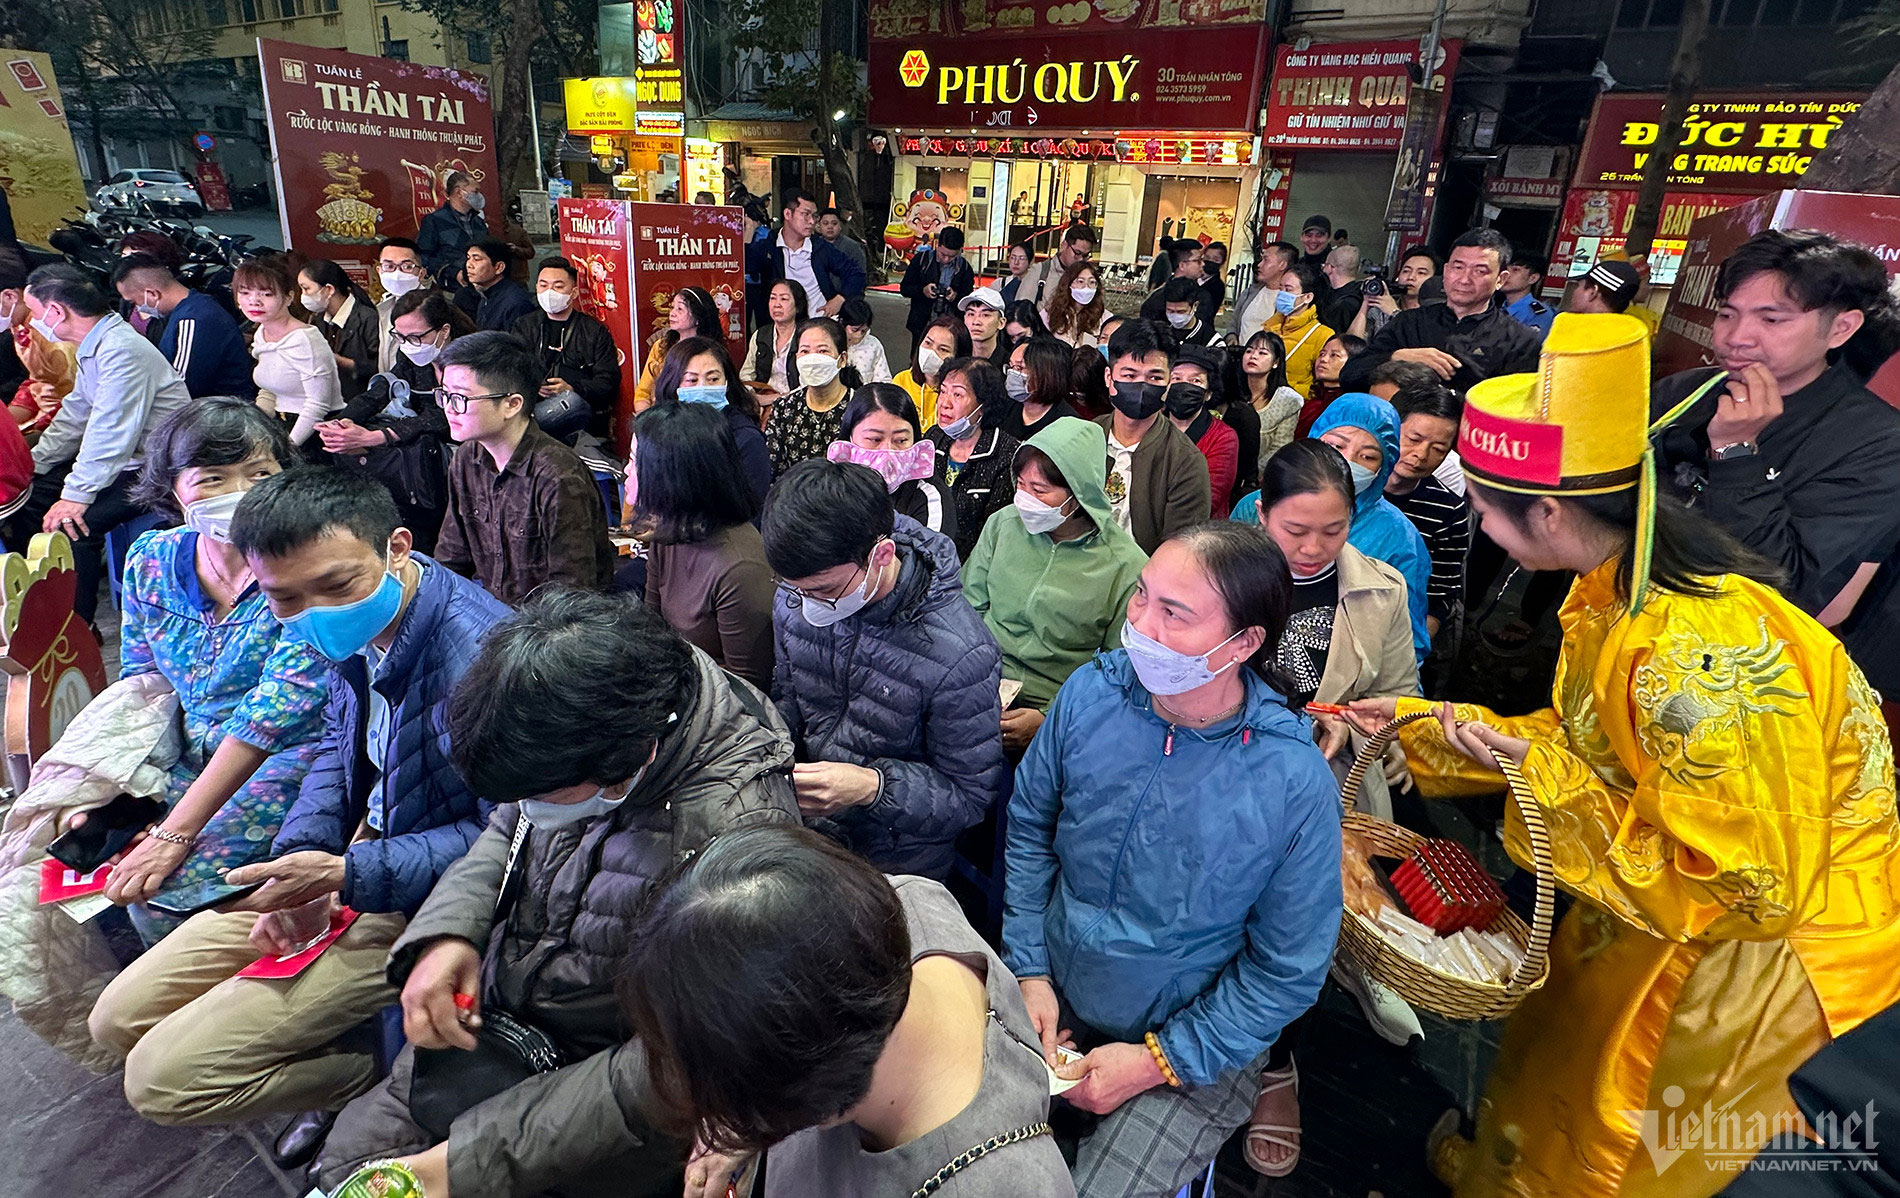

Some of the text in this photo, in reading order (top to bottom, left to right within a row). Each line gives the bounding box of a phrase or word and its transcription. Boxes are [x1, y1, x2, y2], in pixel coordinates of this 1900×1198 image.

[1286, 53, 1307, 67] CÔNG
[1309, 55, 1319, 66] TY
[1320, 52, 1342, 66] VÀNG
[1342, 54, 1360, 68] BẠC
[314, 63, 347, 77] TUẦN
[349, 66, 363, 80] LỄ
[937, 54, 1140, 104] PHÚ QUÝ
[1157, 67, 1175, 83] 30
[1197, 71, 1220, 82] NHÂN
[1221, 71, 1243, 82] TÔNG
[636, 81, 658, 105] NGỌC
[1156, 84, 1207, 94] 024 3573 5959
[1277, 76, 1354, 111] THỊNH
[314, 80, 466, 125] THẦN TÀI
[1155, 94, 1232, 104] www.phuquy.com.vn
[1702, 103, 1720, 113] TY
[1723, 103, 1761, 113] TNHH
[1764, 100, 1797, 113] BẢO
[1799, 100, 1823, 113] TÍN
[290, 114, 483, 146] RƯỚC LỘC VÀNG RỒNG HANH THÔNG THUẬN PHÁT
[1287, 112, 1305, 128] GIỮ
[1305, 113, 1321, 128] TÍN
[1321, 113, 1351, 131] NHIỆM
[1351, 114, 1374, 129] NHƯ
[1373, 112, 1391, 128] GIỮ
[1393, 113, 1406, 128] VÀ
[1619, 113, 1747, 148] ĐỨC
[631, 141, 646, 149] PATE
[1694, 153, 1763, 174] TRANG
[1766, 152, 1813, 175] SÚC
[1511, 180, 1544, 195] BÁNH
[1600, 172, 1617, 181] 26
[1676, 175, 1705, 184] TÔNG
[417, 206, 436, 215] MIN
[1659, 198, 1697, 236] BÁN
[598, 216, 616, 236] TÀI
[656, 232, 732, 256] THẦN TÀI
[1470, 427, 1531, 461] CHÂU
